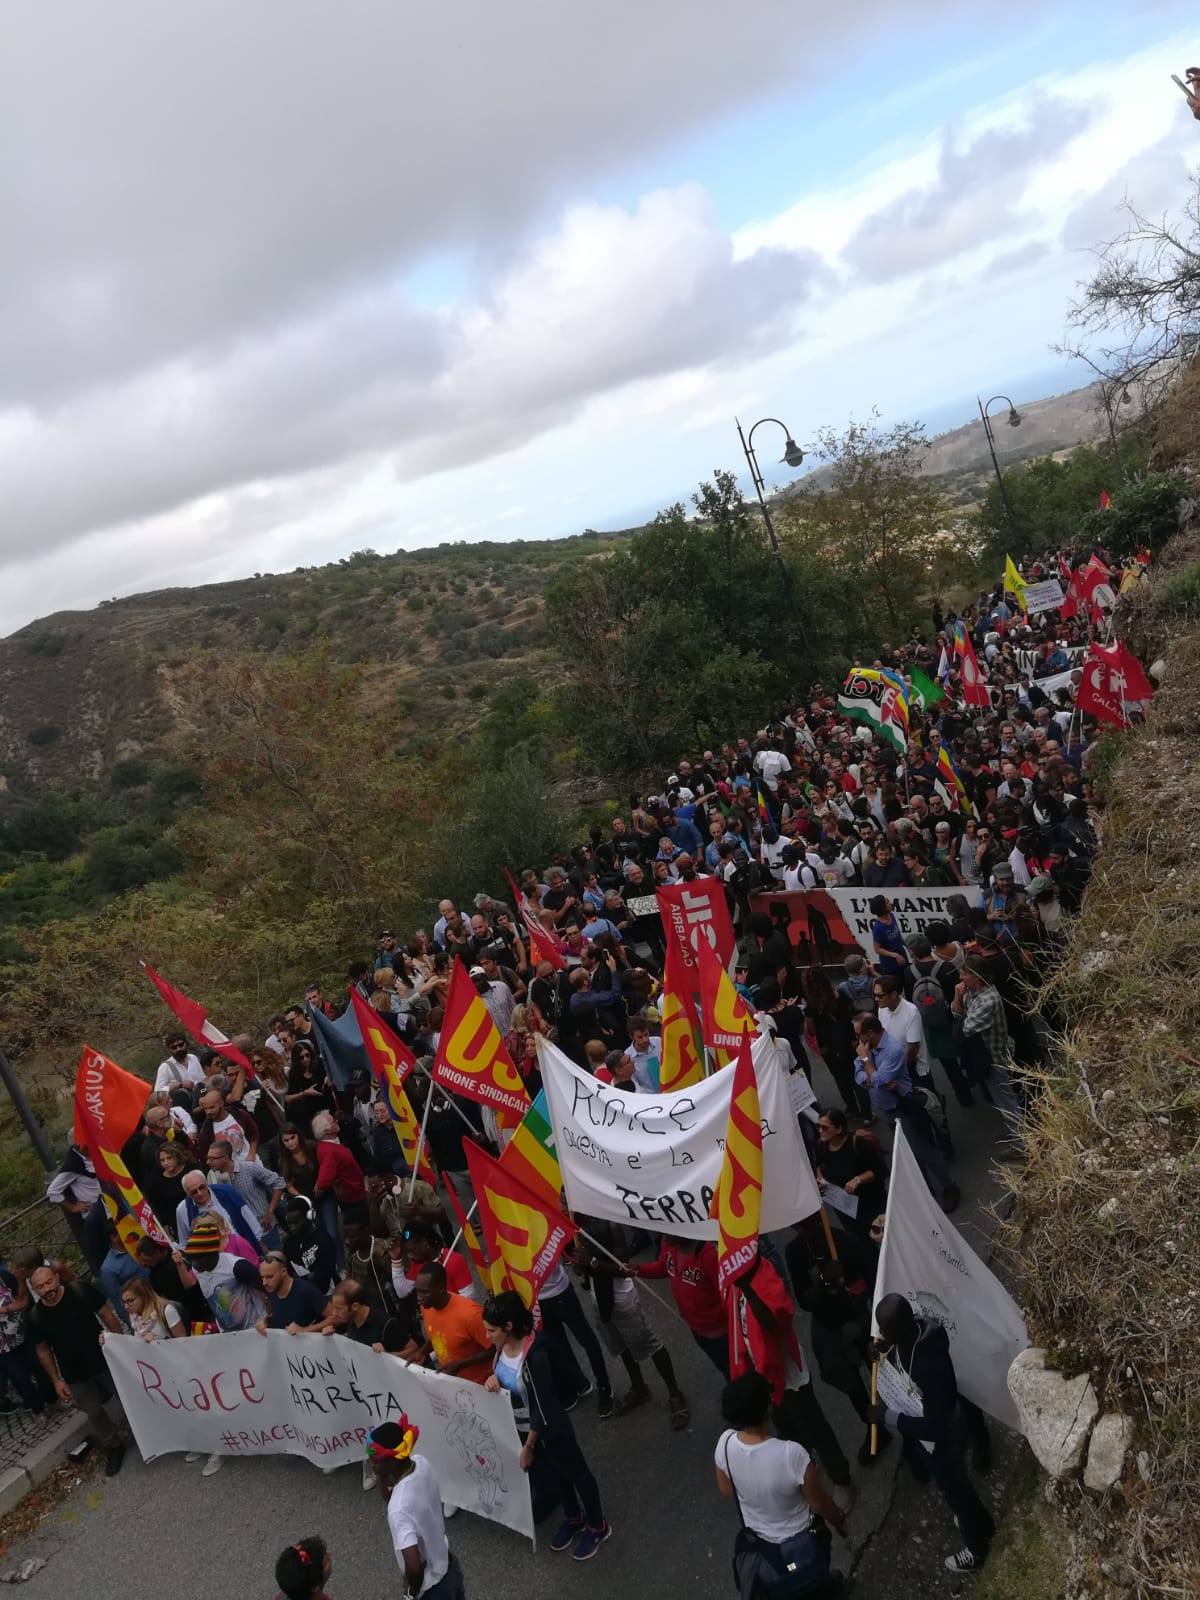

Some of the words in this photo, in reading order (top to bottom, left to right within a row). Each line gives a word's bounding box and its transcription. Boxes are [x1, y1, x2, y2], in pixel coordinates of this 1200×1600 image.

[438, 1064, 477, 1091] UNIONE
[478, 1083, 530, 1114] SINDACALE
[136, 1360, 264, 1412] Riace
[286, 1353, 336, 1381] NON
